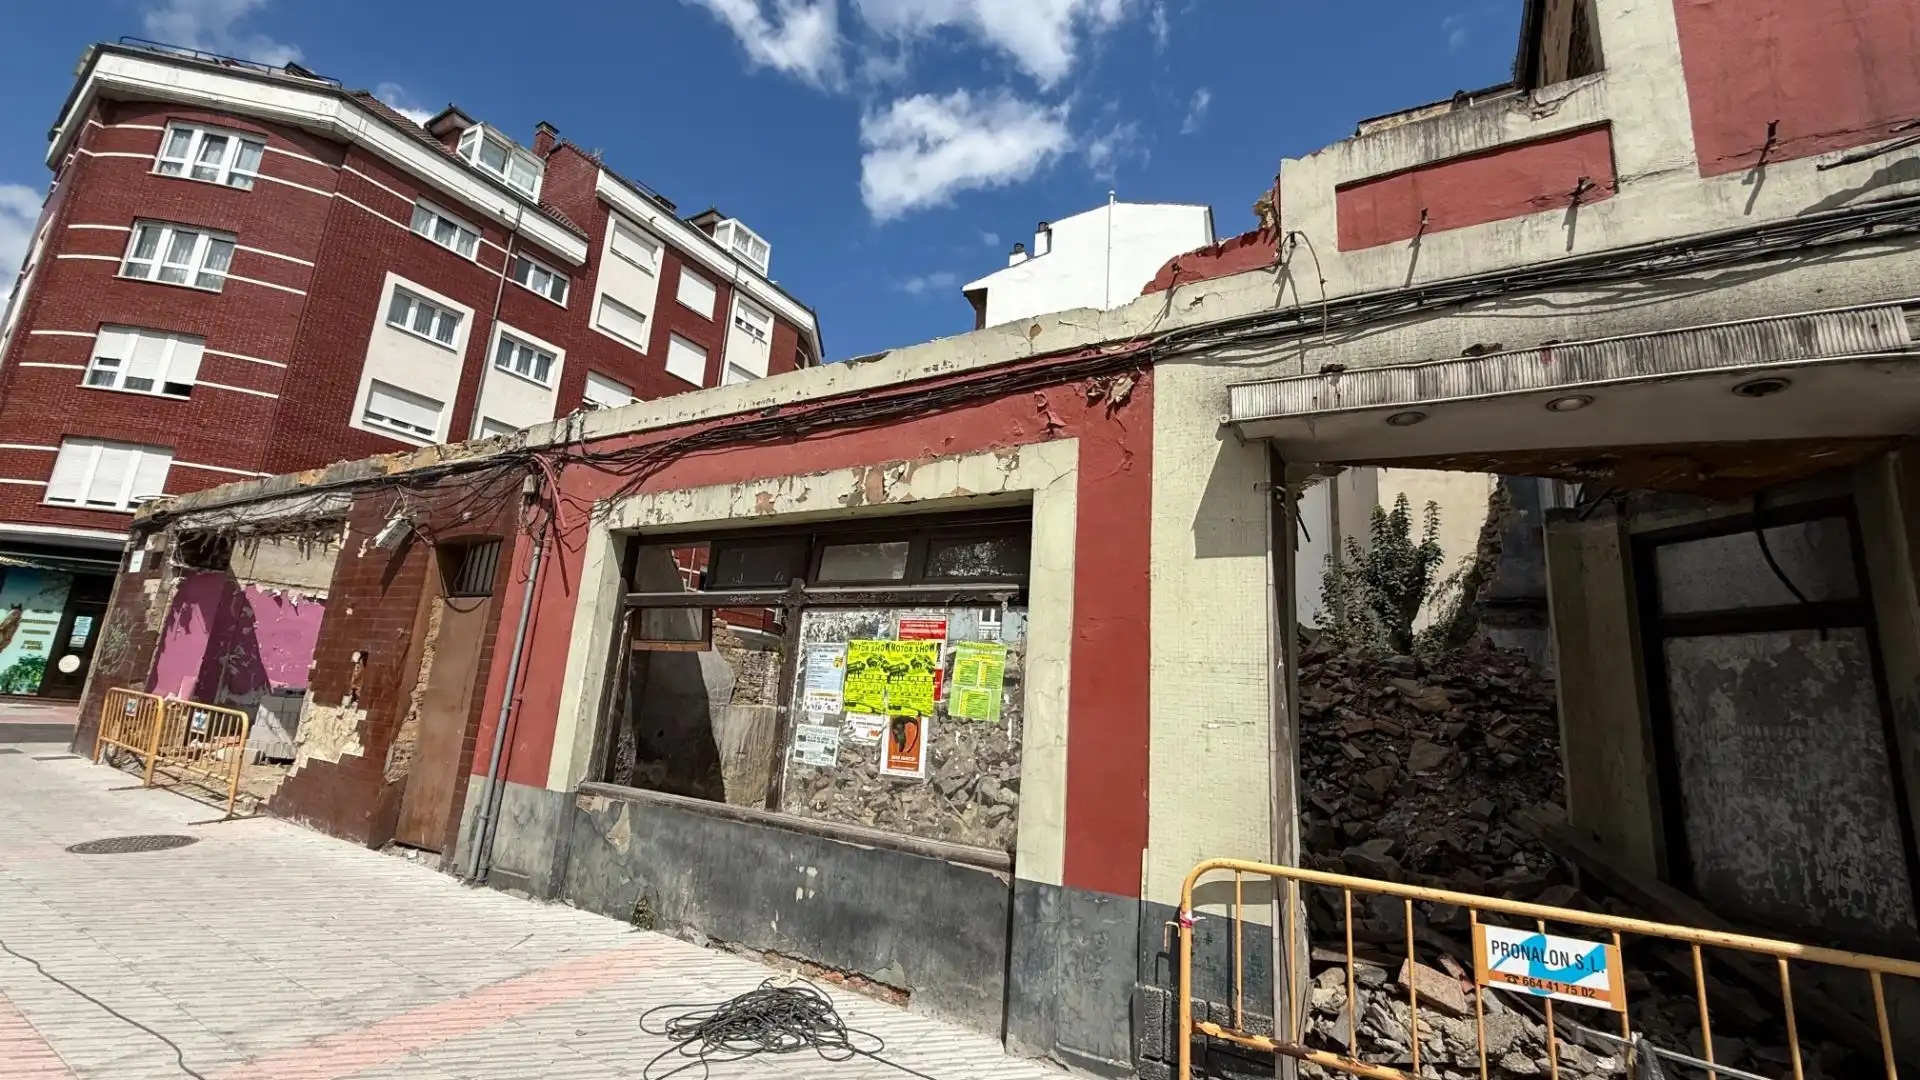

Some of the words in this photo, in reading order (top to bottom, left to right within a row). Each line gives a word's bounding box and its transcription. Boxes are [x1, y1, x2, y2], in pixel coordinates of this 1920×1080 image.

[849, 641, 869, 652] MOTOR
[871, 642, 891, 653] SHOW
[891, 642, 913, 653] MOTOR
[915, 642, 936, 653] SHOW
[1491, 939, 1570, 967] PRONALON
[1575, 953, 1605, 974] S.L.
[1522, 976, 1542, 989] 664
[1545, 980, 1559, 992] 41
[1565, 983, 1578, 995] 75
[1581, 986, 1596, 998] 02
